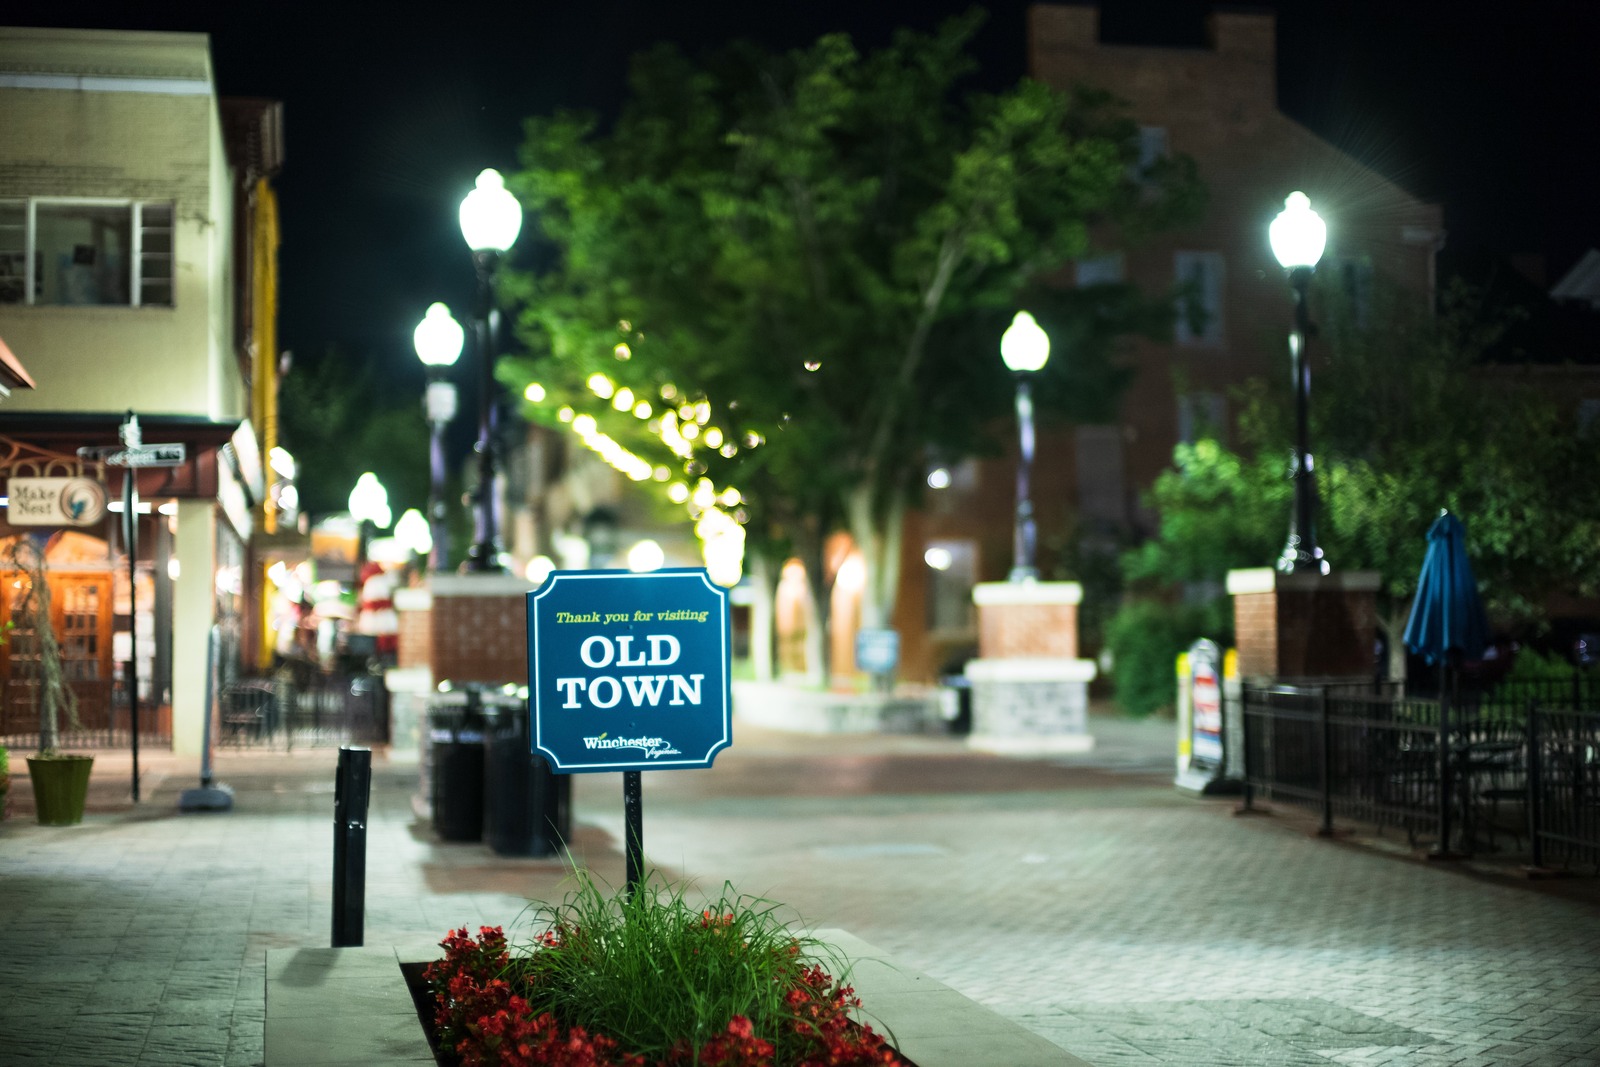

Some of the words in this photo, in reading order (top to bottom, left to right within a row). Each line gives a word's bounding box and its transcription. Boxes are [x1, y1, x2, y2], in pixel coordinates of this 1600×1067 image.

[14, 487, 56, 500] Make
[556, 611, 600, 623] Thank
[603, 613, 628, 625] you
[633, 610, 653, 622] for
[657, 609, 709, 623] visiting
[580, 634, 680, 668] OLD
[556, 674, 704, 709] TOWN
[583, 734, 663, 750] Winchester
[645, 746, 681, 760] Virginia
